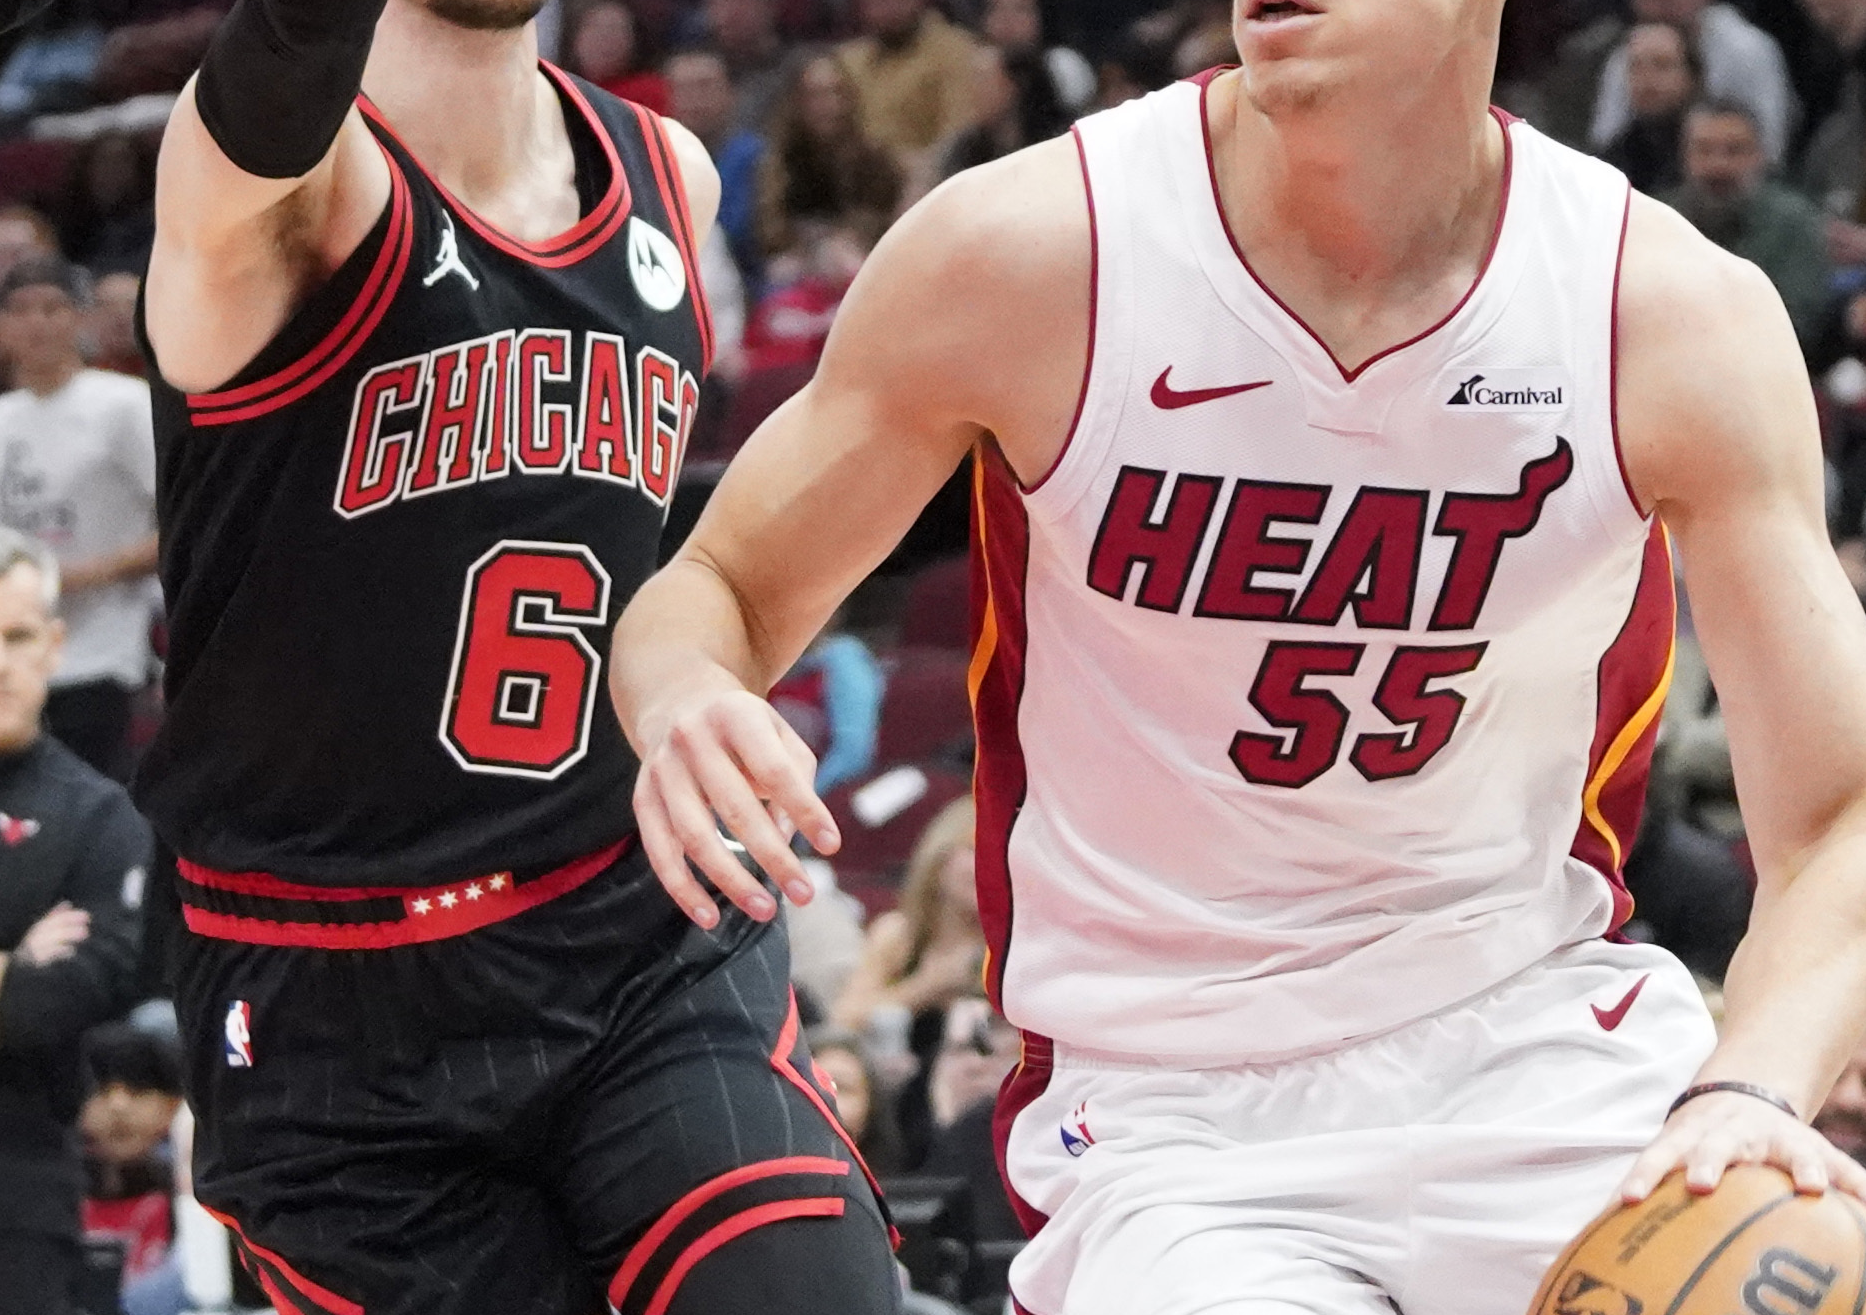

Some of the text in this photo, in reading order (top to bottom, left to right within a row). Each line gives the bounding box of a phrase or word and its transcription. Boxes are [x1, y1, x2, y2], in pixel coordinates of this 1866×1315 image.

[1475, 387, 1563, 405] Carnival
[1086, 434, 1573, 631] HEAT
[439, 539, 612, 780] 6
[1228, 640, 1489, 788] 55
